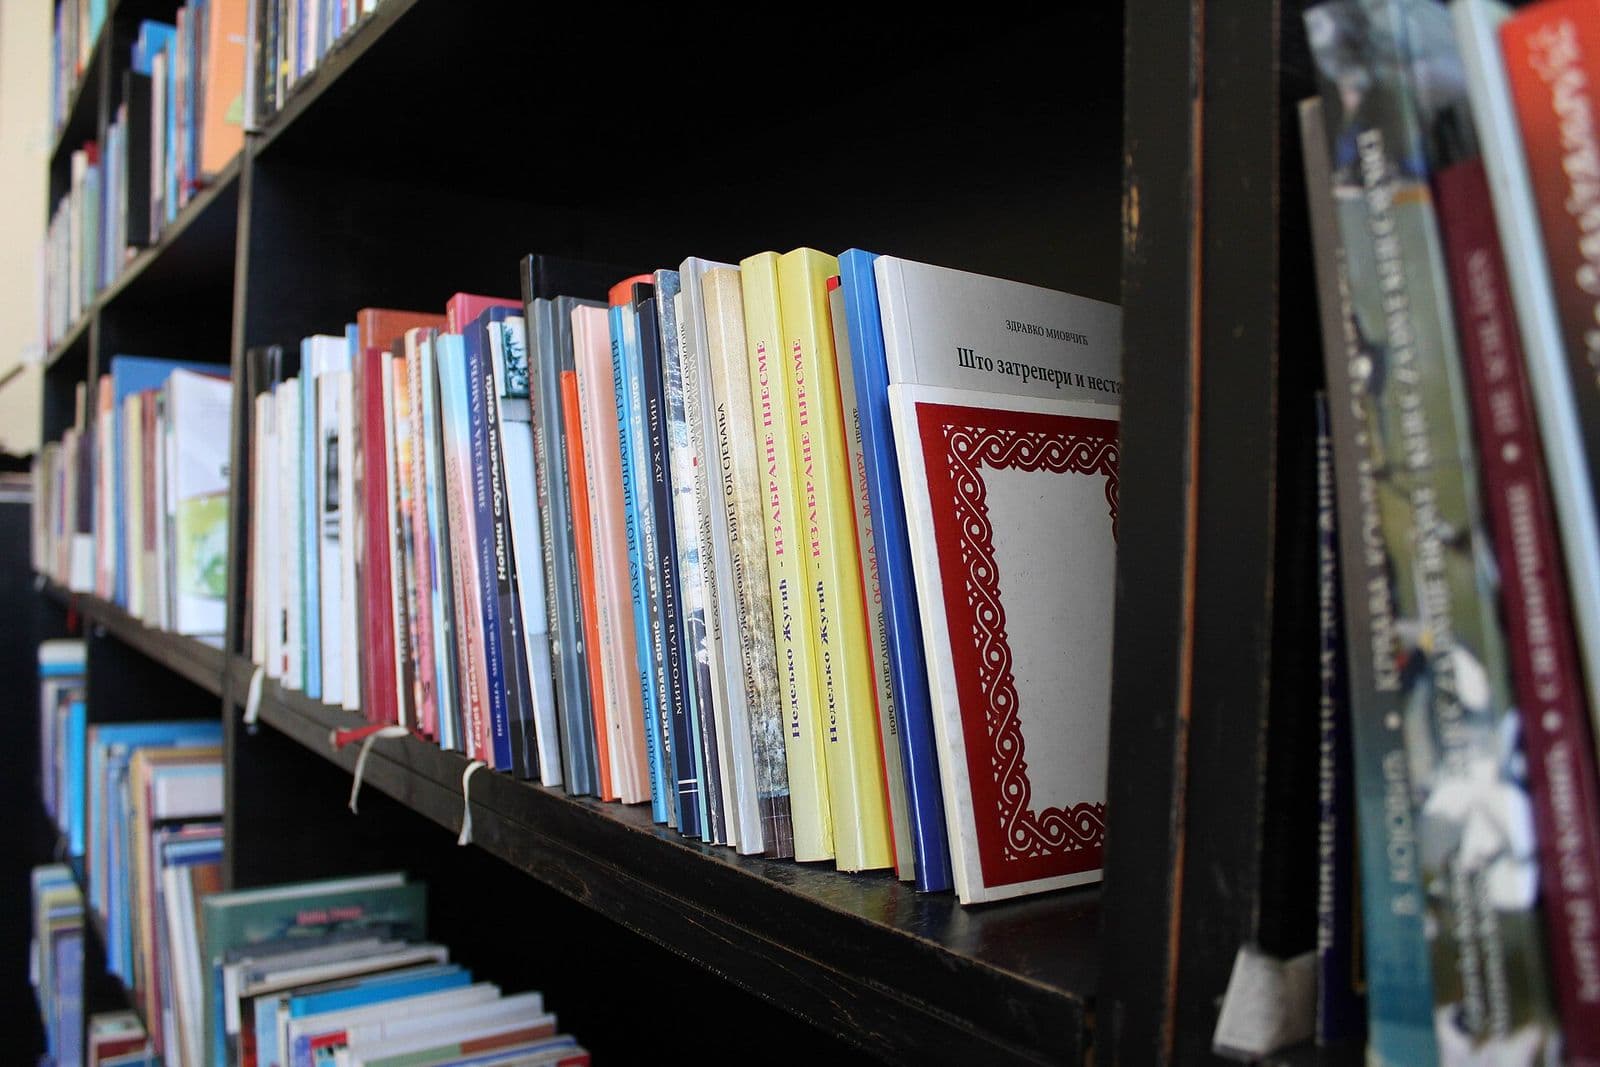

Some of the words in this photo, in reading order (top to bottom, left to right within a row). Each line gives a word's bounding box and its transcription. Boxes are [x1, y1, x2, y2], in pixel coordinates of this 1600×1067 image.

[1005, 319, 1044, 337] ЗДРАВКО
[485, 374, 496, 424] сенки
[611, 338, 625, 422] СТУДЕНТИ
[756, 340, 773, 427] ПЈЕСМЕ
[792, 338, 809, 427] ПЈЕСМЕ
[957, 347, 993, 372] Што
[997, 359, 1071, 389] затрепери
[1074, 373, 1085, 387] и
[650, 397, 658, 431] ЧИН
[652, 436, 659, 448] И
[717, 402, 731, 471] СЈЕЋАЊА
[488, 429, 502, 517] скупљачи
[618, 428, 632, 507] ПРОПАЛИ
[653, 450, 663, 483] ДУХ
[724, 472, 733, 496] ОД
[764, 432, 784, 556] ИЗАБРАНЕ
[801, 431, 821, 558] ИЗАБРАНЕ
[493, 522, 507, 580] Ноћни
[625, 514, 635, 551] НОЋ
[642, 506, 655, 570] KONDORA
[703, 514, 715, 568] Жугић
[727, 502, 738, 544] БИЈЕГ
[865, 527, 873, 538] У
[546, 565, 559, 632] Миленко
[629, 559, 641, 606] ЛАКУ
[647, 574, 657, 599] LET
[663, 555, 674, 619] ЕГЕРИЋ
[708, 570, 721, 641] Недељко
[734, 553, 747, 631] Живковић
[868, 545, 881, 605] ОСАМА
[779, 578, 793, 641] Жугић
[815, 580, 829, 644] Жугић
[669, 624, 682, 715] МИРОСЛАВ
[743, 634, 756, 708] Мирослав
[786, 648, 800, 739] Недељко
[823, 651, 838, 743] Недељко
[657, 666, 671, 753] ALEKSANDAR
[887, 704, 897, 736] БОРО
